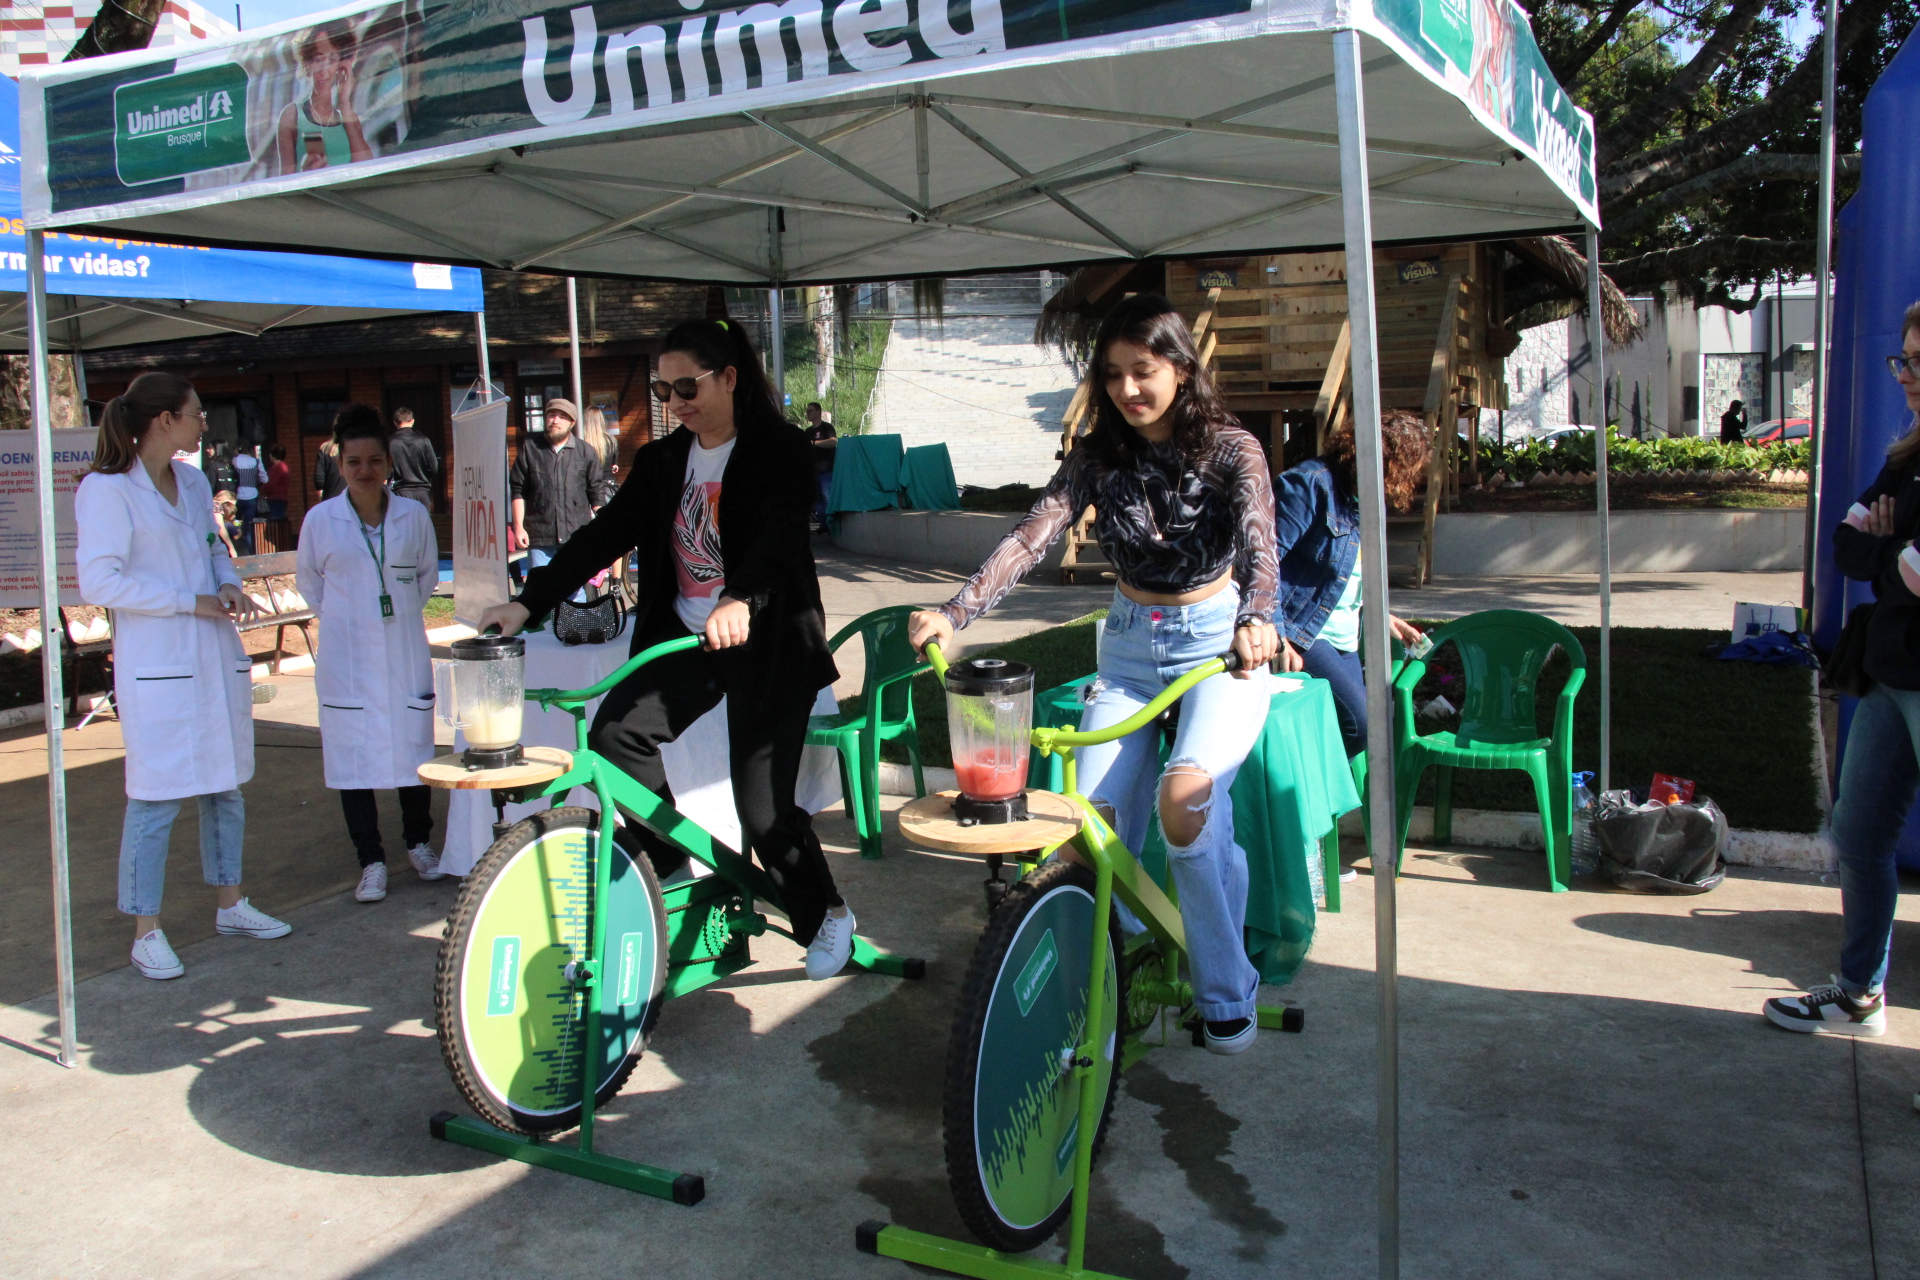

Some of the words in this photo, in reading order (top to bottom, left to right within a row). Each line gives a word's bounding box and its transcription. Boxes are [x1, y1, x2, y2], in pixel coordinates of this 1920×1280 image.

[127, 96, 203, 134] Unimed
[167, 131, 202, 147] Brusque
[69, 252, 150, 277] vidas?
[1402, 266, 1438, 280] VISUAL
[1201, 279, 1233, 287] VISUAL
[11, 469, 29, 477] sabia
[465, 466, 487, 500] RENAL
[465, 500, 499, 562] VIDA
